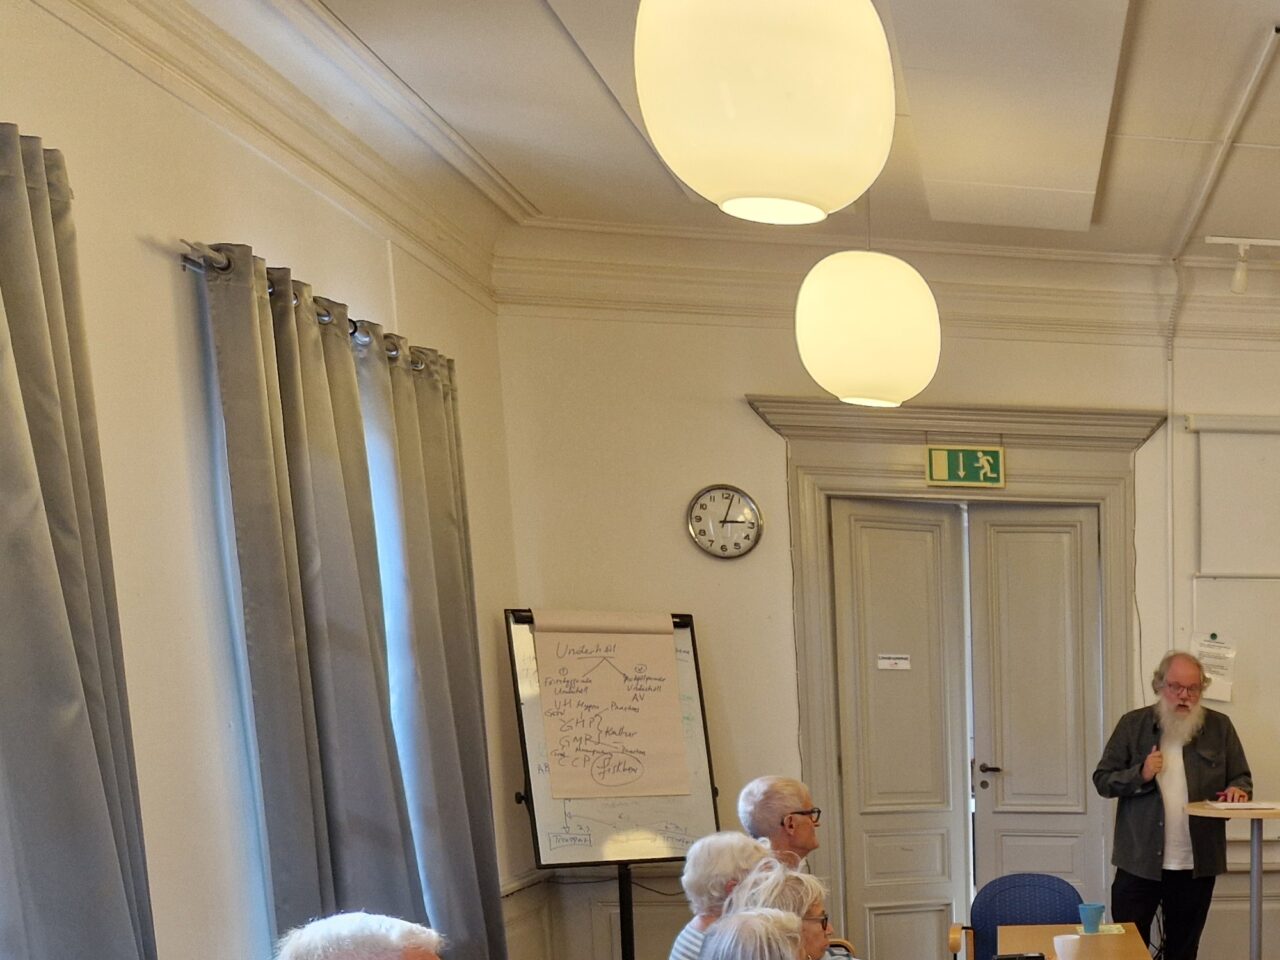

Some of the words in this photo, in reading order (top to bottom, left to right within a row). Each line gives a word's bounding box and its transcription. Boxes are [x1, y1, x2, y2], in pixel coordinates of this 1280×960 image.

[721, 492, 731, 500] 12
[694, 515, 702, 523] 9
[747, 521, 755, 529] 3
[698, 529, 706, 537] 8
[743, 533, 751, 541] 4
[707, 539, 715, 547] 7
[733, 542, 742, 550] 5
[720, 544, 728, 552] 6
